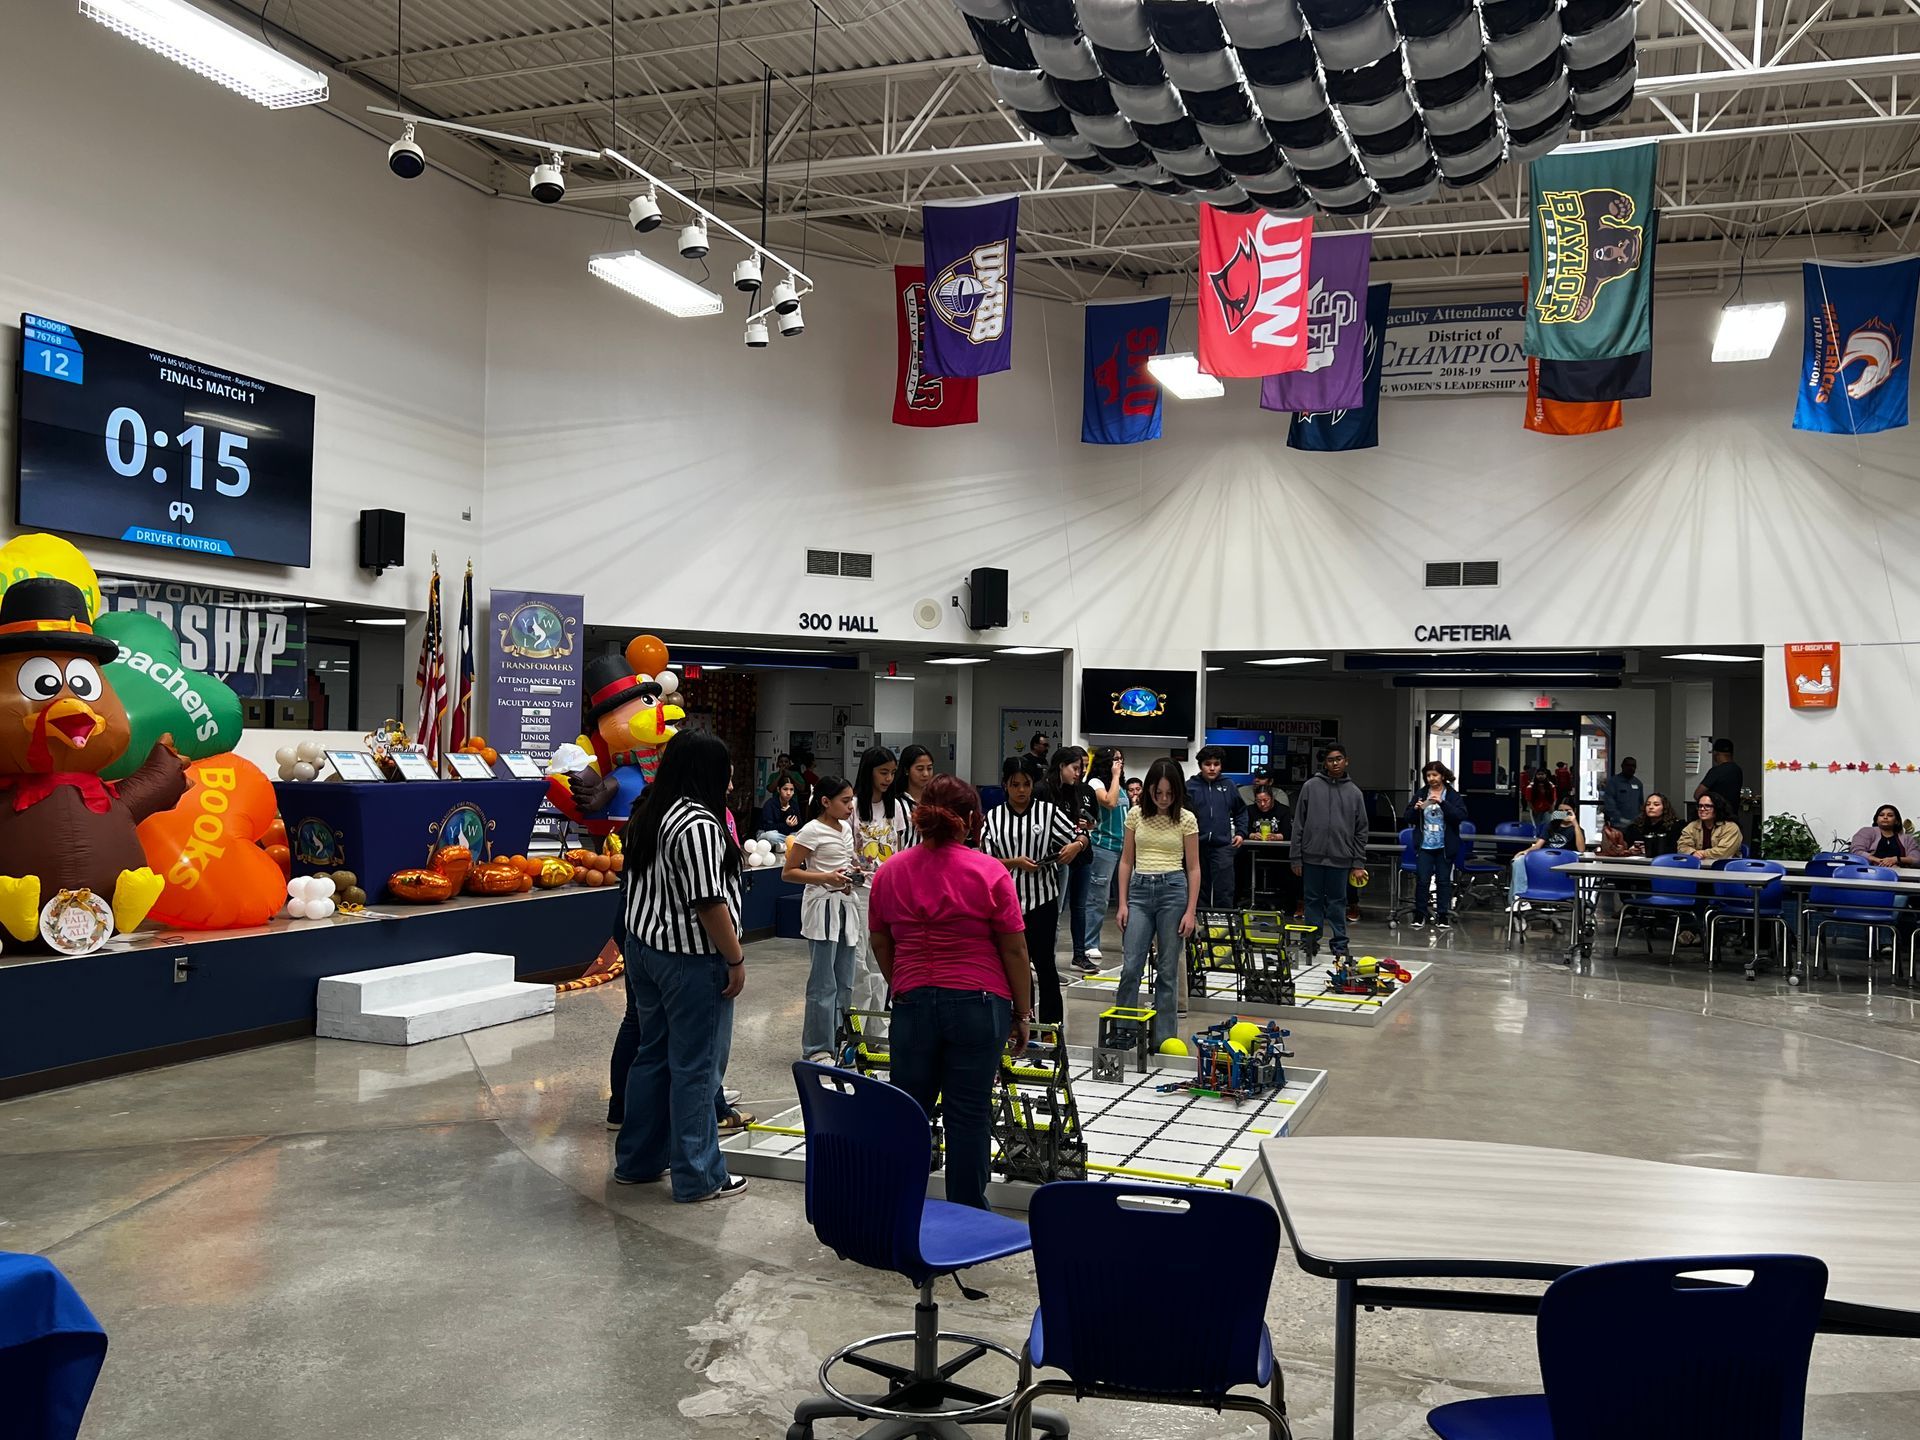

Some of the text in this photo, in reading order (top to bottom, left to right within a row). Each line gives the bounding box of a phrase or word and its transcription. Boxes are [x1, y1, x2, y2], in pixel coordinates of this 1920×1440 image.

[1541, 192, 1586, 322] BAYLOR
[1545, 219, 1557, 294] BEARS
[1252, 212, 1303, 346] UIW
[970, 240, 1008, 344] UMHB
[1386, 310, 1429, 325] aculty
[1433, 304, 1514, 321] Attendance
[36, 319, 67, 333] 45009P
[1428, 327, 1502, 343] District of
[36, 330, 62, 345] 7676B
[1381, 340, 1527, 368] CHAMPION
[1809, 317, 1823, 387] UT ARLINGTON
[1815, 303, 1840, 404] MAVERICKS
[40, 349, 69, 377] 12
[1440, 366, 1482, 377] 2018-19
[149, 353, 167, 364] YWLA
[167, 358, 178, 366] MS
[177, 360, 197, 372] VIQRC
[197, 366, 232, 382] Tournament
[234, 376, 251, 388] Rapid
[250, 381, 266, 393] Relay
[160, 367, 255, 404] FINALS MATCH 1
[1391, 381, 1442, 392] WOMEN'S
[1444, 379, 1516, 391] LEADERSHIP
[105, 406, 251, 498] 0:15
[136, 530, 223, 553] DRIVER CONTROL
[134, 583, 286, 614] WOMEN'S
[522, 618, 554, 628] Y W
[799, 612, 879, 633] 300 HALL
[1414, 624, 1512, 642] CAFETERIA
[524, 638, 529, 648] L
[1791, 644, 1833, 652] SELF-DISCIPLINE
[501, 661, 574, 672] TRANSFORMERS
[108, 639, 219, 742] eachers
[497, 676, 576, 686] ATTENDANCE RATES
[498, 699, 531, 707] FACULTY
[552, 700, 574, 708] STAFF
[521, 716, 550, 724] SENIOR
[1027, 719, 1059, 727] YWLA
[1239, 720, 1320, 734] ANNOUNCEMENTS
[520, 733, 550, 741] JUNIOR
[168, 766, 237, 890] Books
[450, 825, 478, 838] Y W
